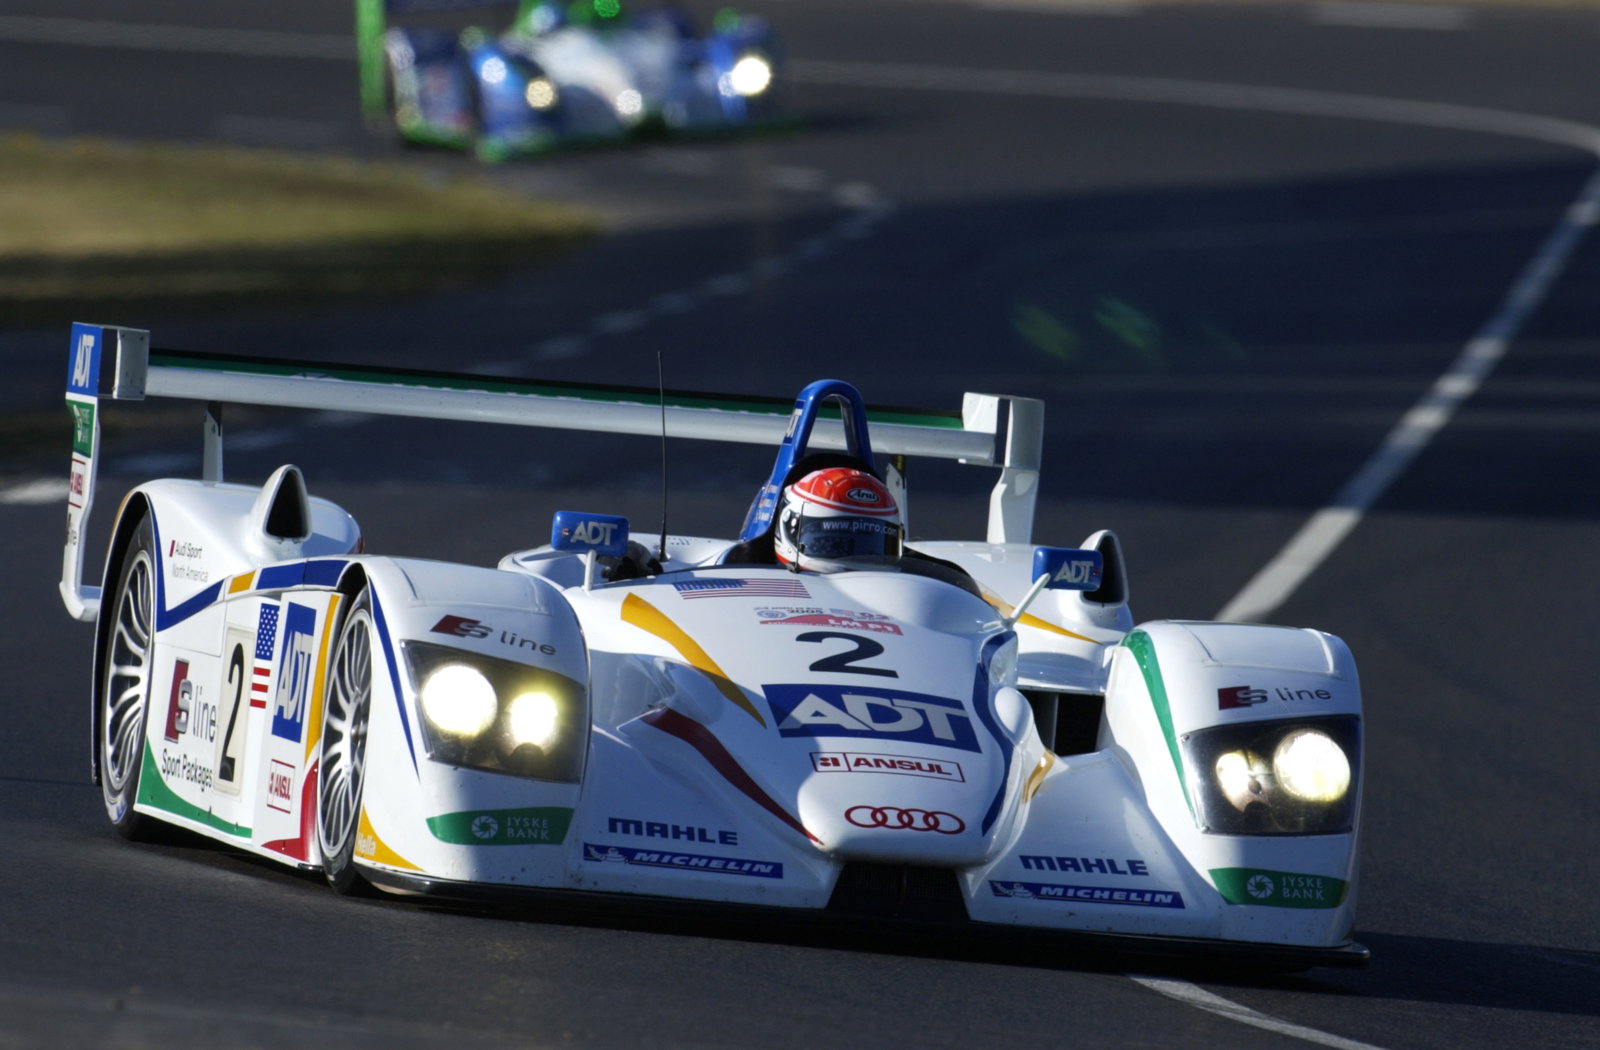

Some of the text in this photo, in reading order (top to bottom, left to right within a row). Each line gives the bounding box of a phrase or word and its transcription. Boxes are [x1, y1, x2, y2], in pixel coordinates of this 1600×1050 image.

[72, 333, 95, 389] ADT
[570, 520, 618, 546] ADT
[186, 542, 203, 560] Sport
[1053, 560, 1094, 584] ADT
[500, 630, 557, 656] line
[796, 631, 899, 679] 2
[273, 630, 314, 724] ADT
[1275, 687, 1332, 701] line
[192, 685, 218, 743] line
[219, 643, 245, 783] 2
[777, 692, 970, 742] ADT
[162, 748, 214, 793] Sport Packages
[853, 757, 953, 776] ANSUL
[506, 816, 549, 829] JYSKE
[506, 828, 550, 841] BANK
[608, 817, 738, 846] MAHLE
[633, 852, 775, 874] MICHELIN
[1018, 855, 1150, 876] MAHLE
[1281, 876, 1324, 888] JYSKE
[1282, 887, 1325, 901] BANK
[1039, 886, 1174, 904] MICHELIN
